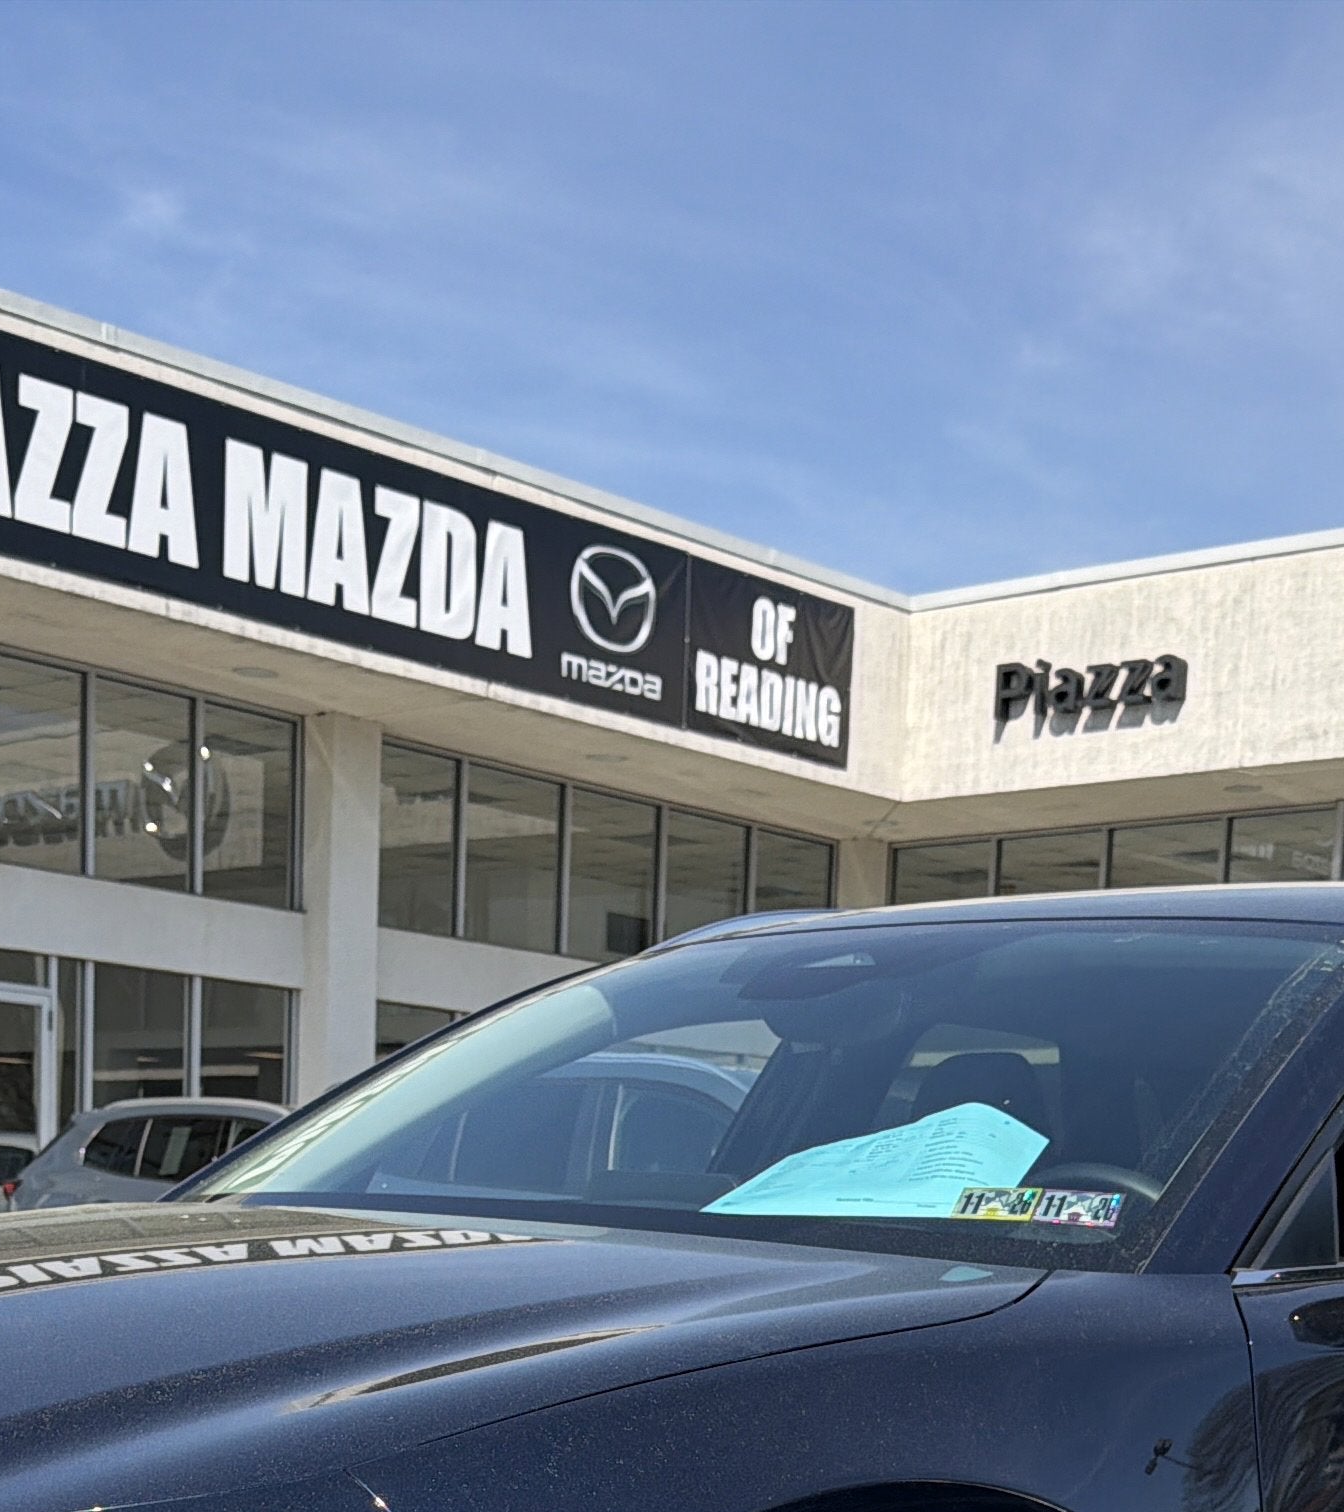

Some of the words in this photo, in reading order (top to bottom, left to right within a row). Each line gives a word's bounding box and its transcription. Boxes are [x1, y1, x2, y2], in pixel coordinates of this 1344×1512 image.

[223, 437, 532, 659] MAZDA
[752, 597, 795, 662] OF
[561, 651, 662, 701] mazda
[696, 650, 841, 749] READING
[994, 653, 1188, 724] Piazza
